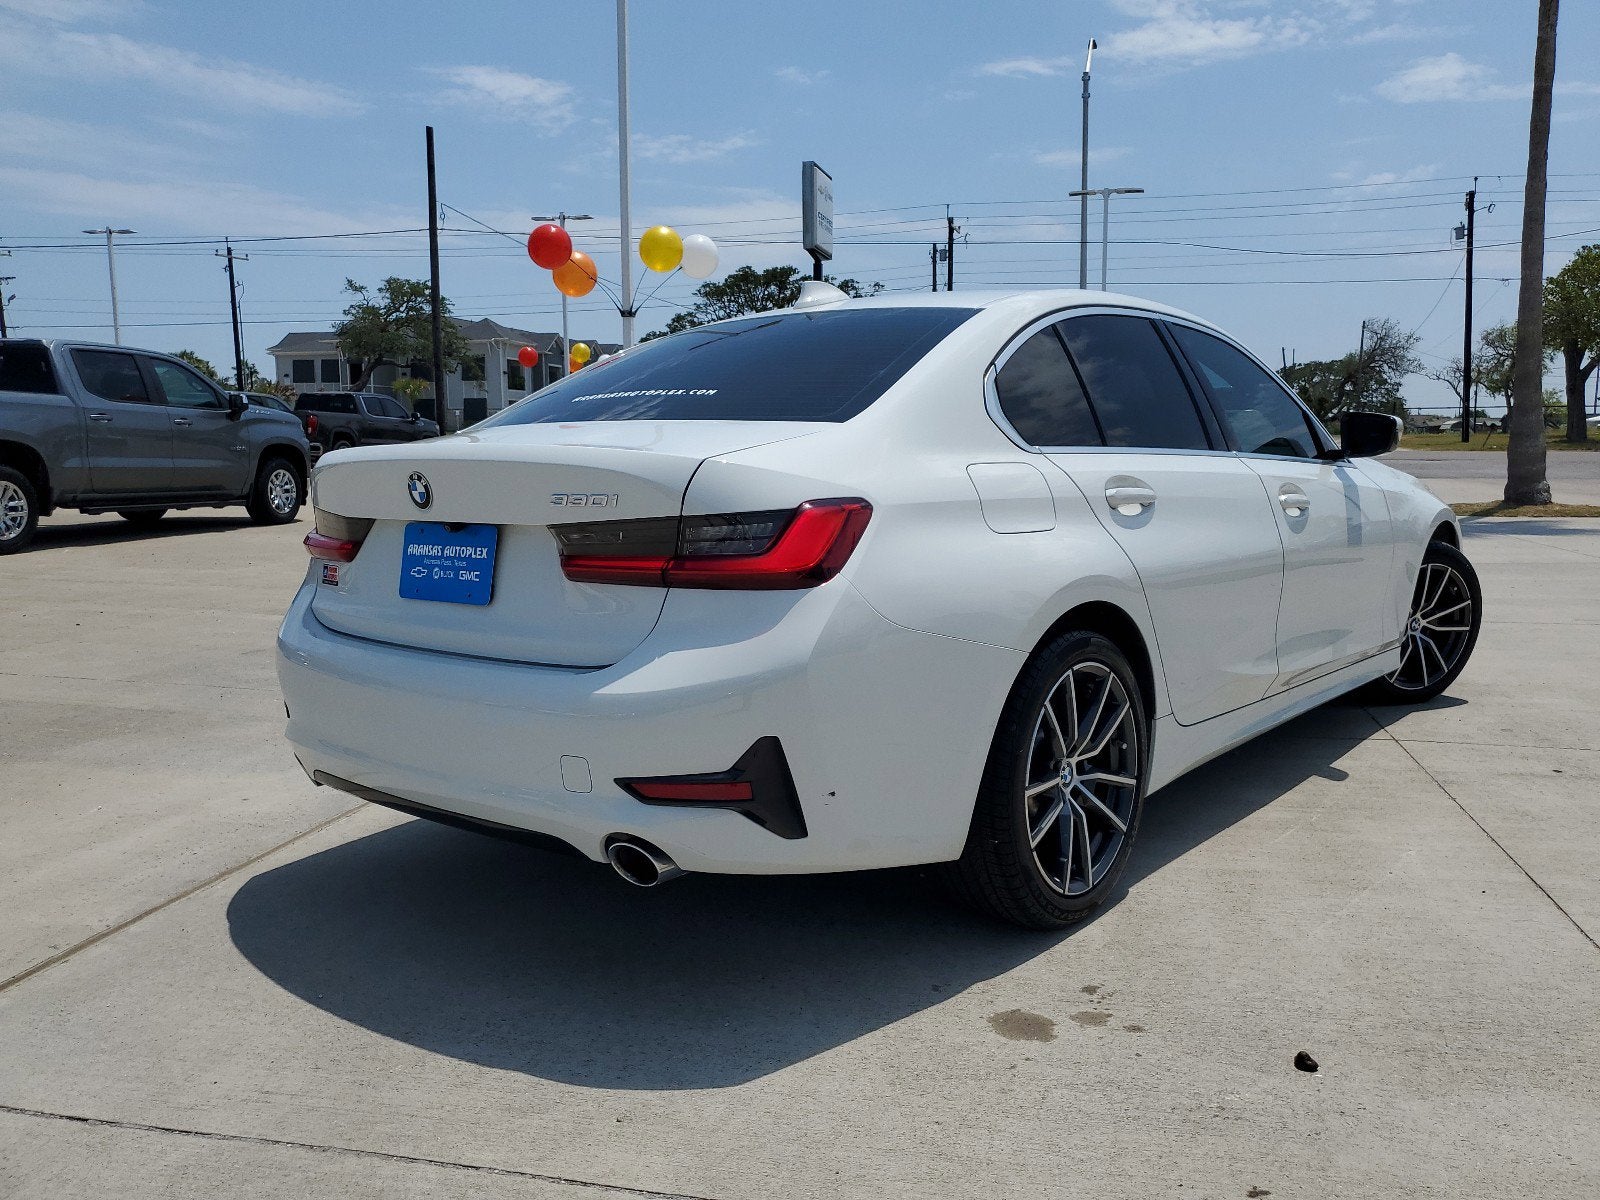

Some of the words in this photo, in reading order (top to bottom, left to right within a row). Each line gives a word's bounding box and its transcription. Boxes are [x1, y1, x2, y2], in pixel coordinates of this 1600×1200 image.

[407, 543, 443, 557] ARANSAS
[443, 545, 489, 559] AUTOPLEX
[458, 570, 481, 582] GMC
